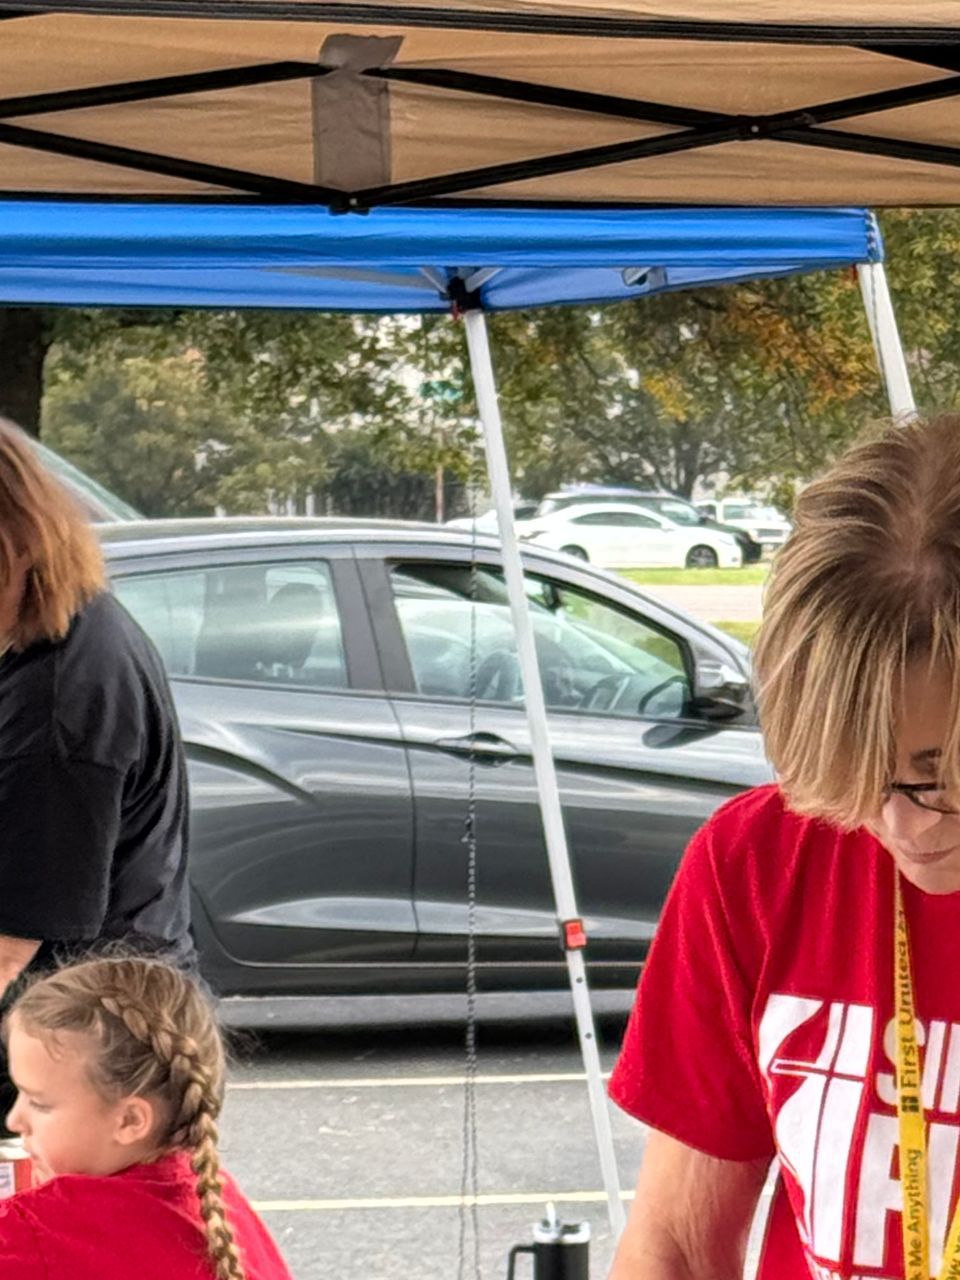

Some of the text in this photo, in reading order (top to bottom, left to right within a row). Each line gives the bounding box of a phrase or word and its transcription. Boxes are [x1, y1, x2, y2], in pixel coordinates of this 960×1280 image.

[898, 941, 918, 1089] First United
[906, 1148, 924, 1233] Anything
[908, 1238, 922, 1269] Me
